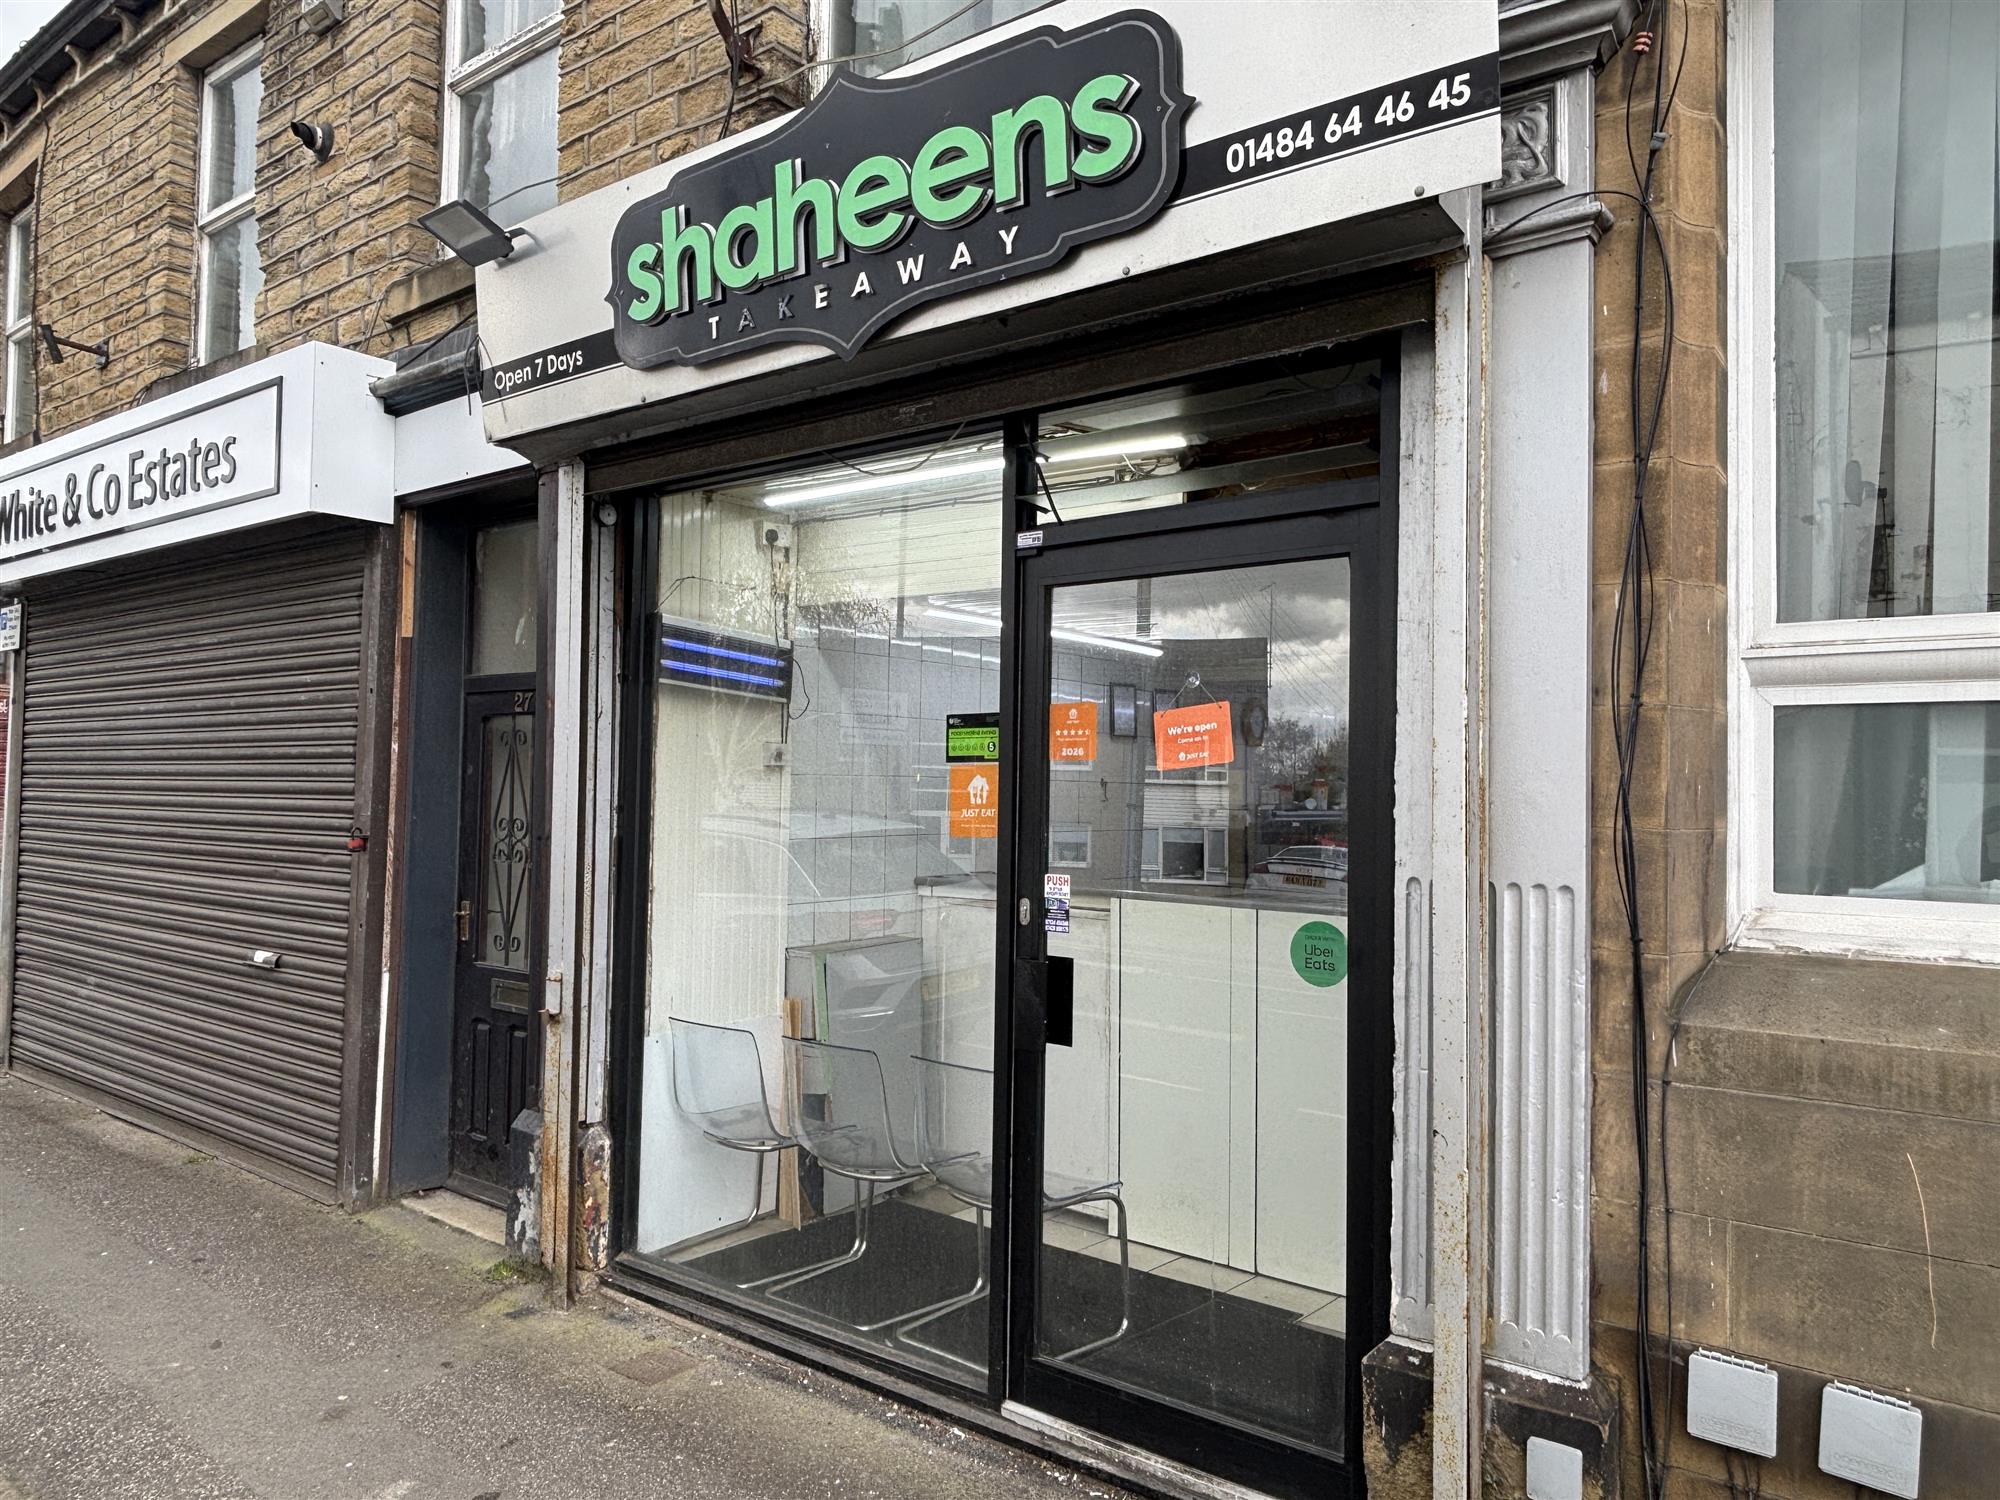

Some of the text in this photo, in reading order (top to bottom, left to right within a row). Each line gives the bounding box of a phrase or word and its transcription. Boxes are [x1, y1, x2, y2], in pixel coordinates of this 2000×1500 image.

[1226, 72, 1471, 173] 01484 64 46 45
[627, 74, 1138, 324] shaheens
[708, 226, 1020, 340] TAKEAWAY
[494, 350, 583, 392] Open 7 Days
[0, 435, 237, 544] White & Co Estates
[514, 691, 534, 712] 27
[1168, 722, 1217, 736] We're open
[988, 742, 995, 752] 5
[960, 808, 996, 818] JUST EAT
[1046, 875, 1069, 887] PUSH
[1304, 957, 1336, 972] Eats
